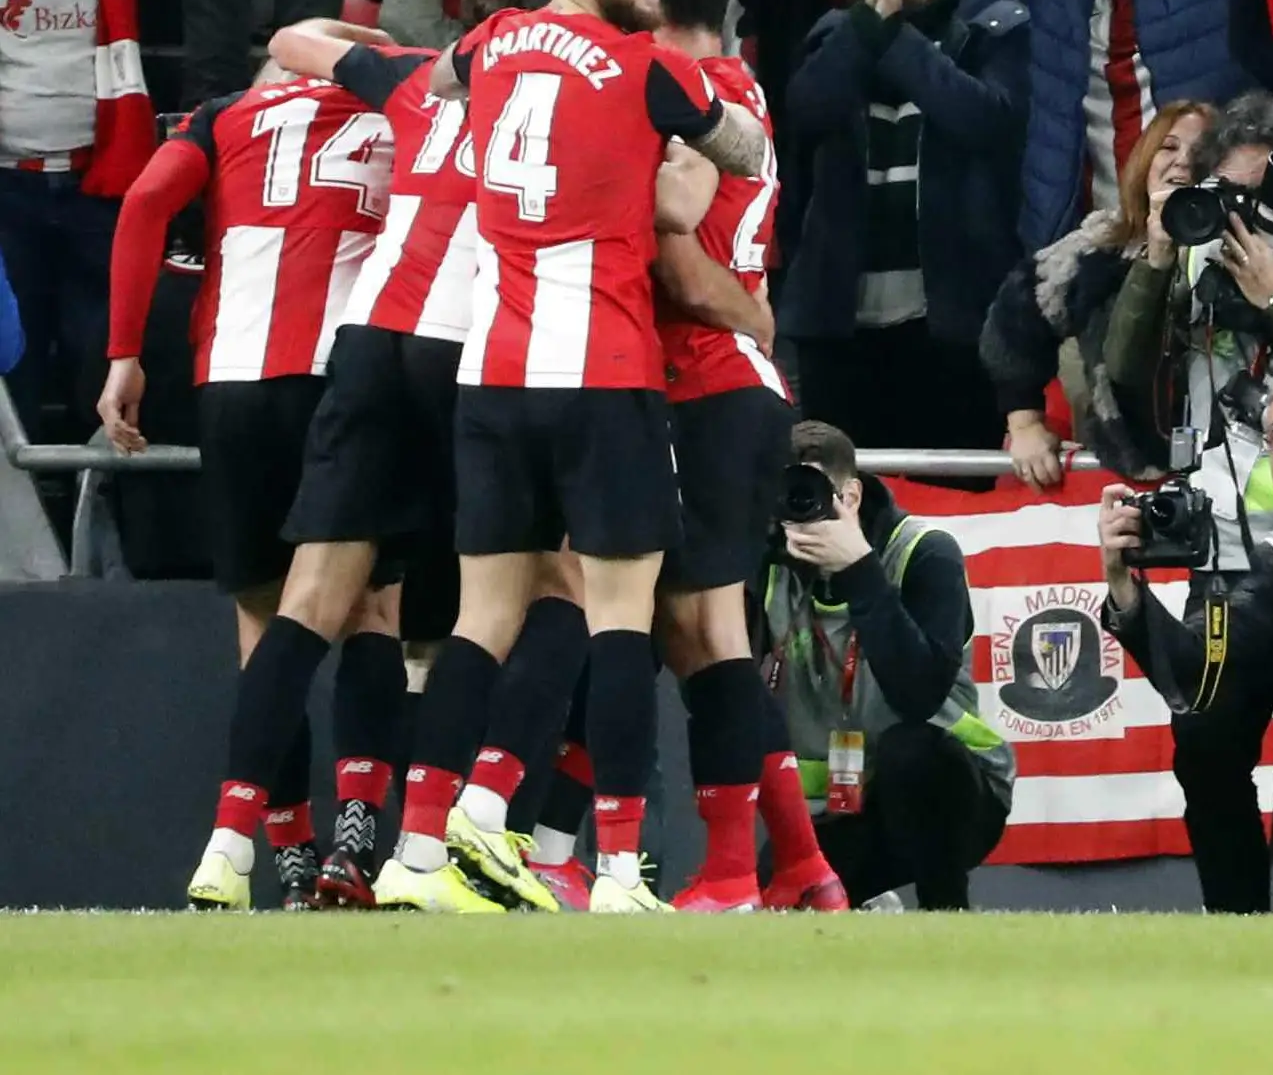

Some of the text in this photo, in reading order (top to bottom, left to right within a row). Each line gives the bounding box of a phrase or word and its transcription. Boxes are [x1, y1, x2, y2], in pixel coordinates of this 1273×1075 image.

[251, 97, 395, 221] 14
[484, 72, 563, 222] 4
[998, 708, 1066, 737] FUNDADA
[1069, 721, 1093, 736] EN
